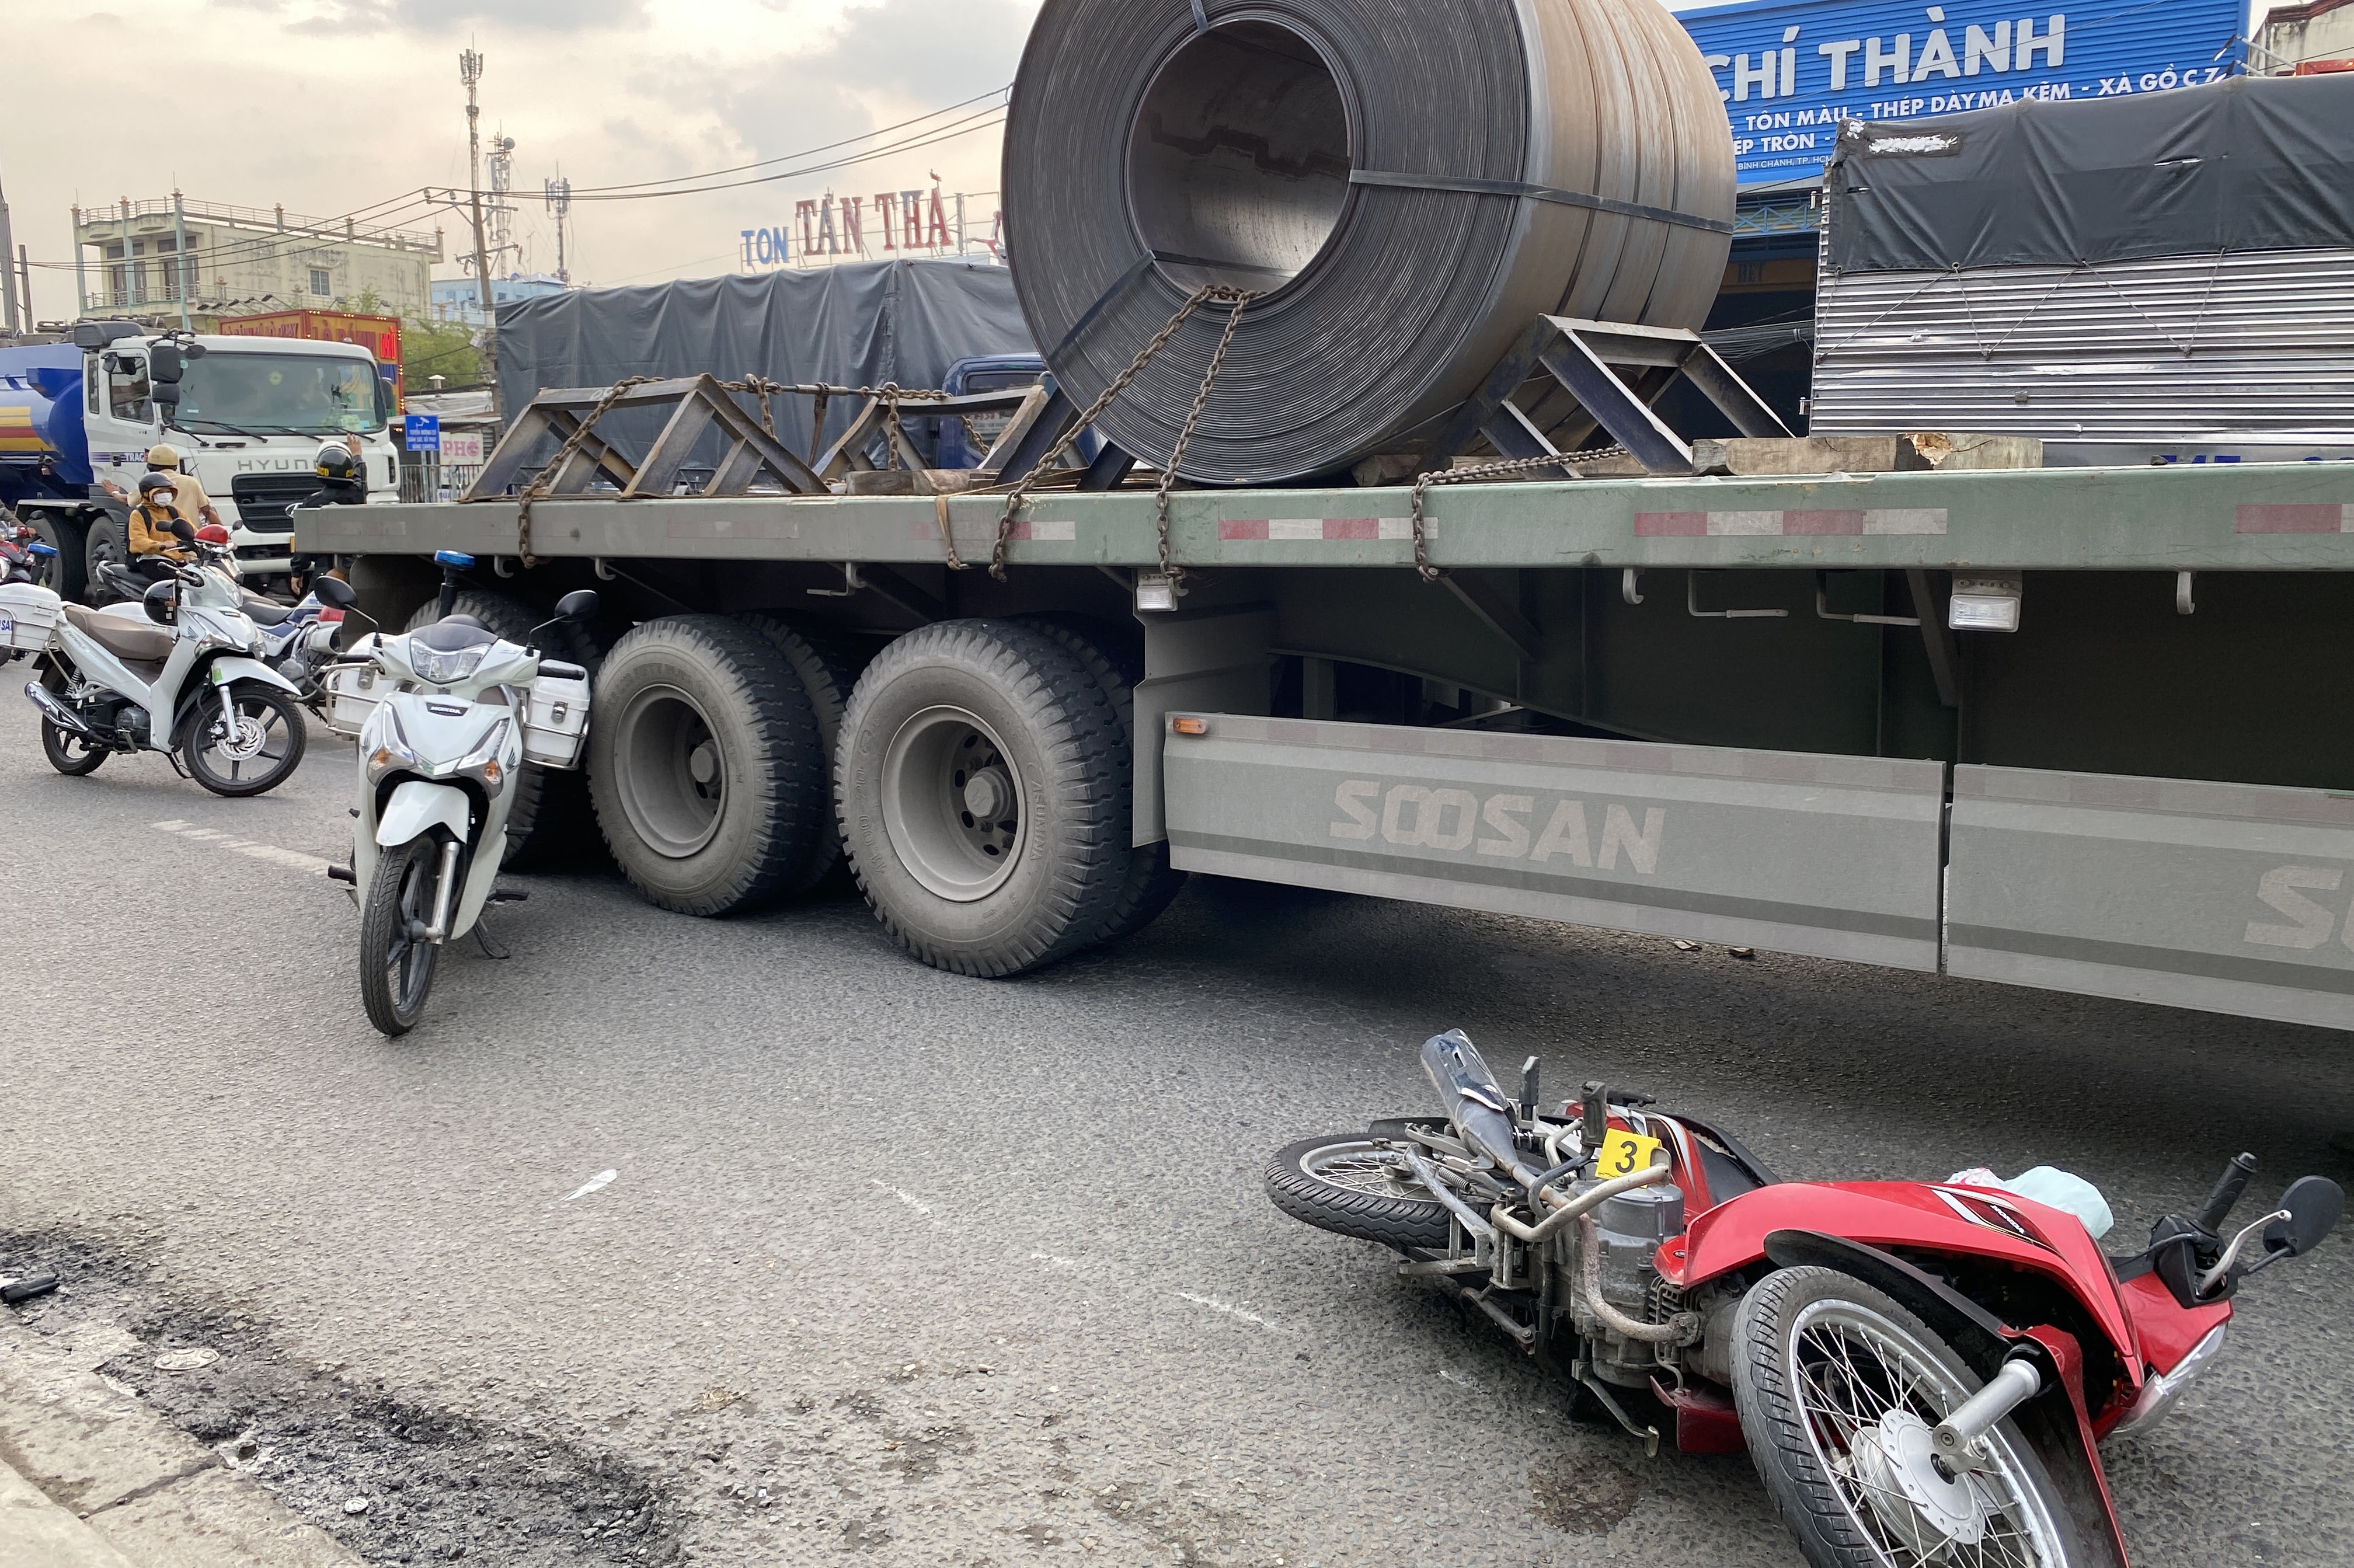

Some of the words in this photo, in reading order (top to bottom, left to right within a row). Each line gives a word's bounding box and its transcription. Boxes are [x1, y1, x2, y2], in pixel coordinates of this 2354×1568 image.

[1818, 6, 2066, 91] THÀNH
[1746, 110, 1790, 131] TÔN
[1797, 104, 1848, 126] MÀU
[1871, 95, 1924, 119] THÉP
[2098, 72, 2133, 96] XÀ
[2140, 64, 2178, 91] GỒ
[1734, 135, 1754, 155] ÉP
[1761, 130, 1815, 152] TRÒN
[124, 452, 144, 462] TRAG
[237, 459, 318, 471] HYUN
[430, 706, 462, 715] HONDA
[1329, 779, 1667, 874] SOOSAN
[2243, 865, 2354, 954] S
[1615, 1140, 1638, 1173] 3
[1990, 1205, 2025, 1235] HONDA
